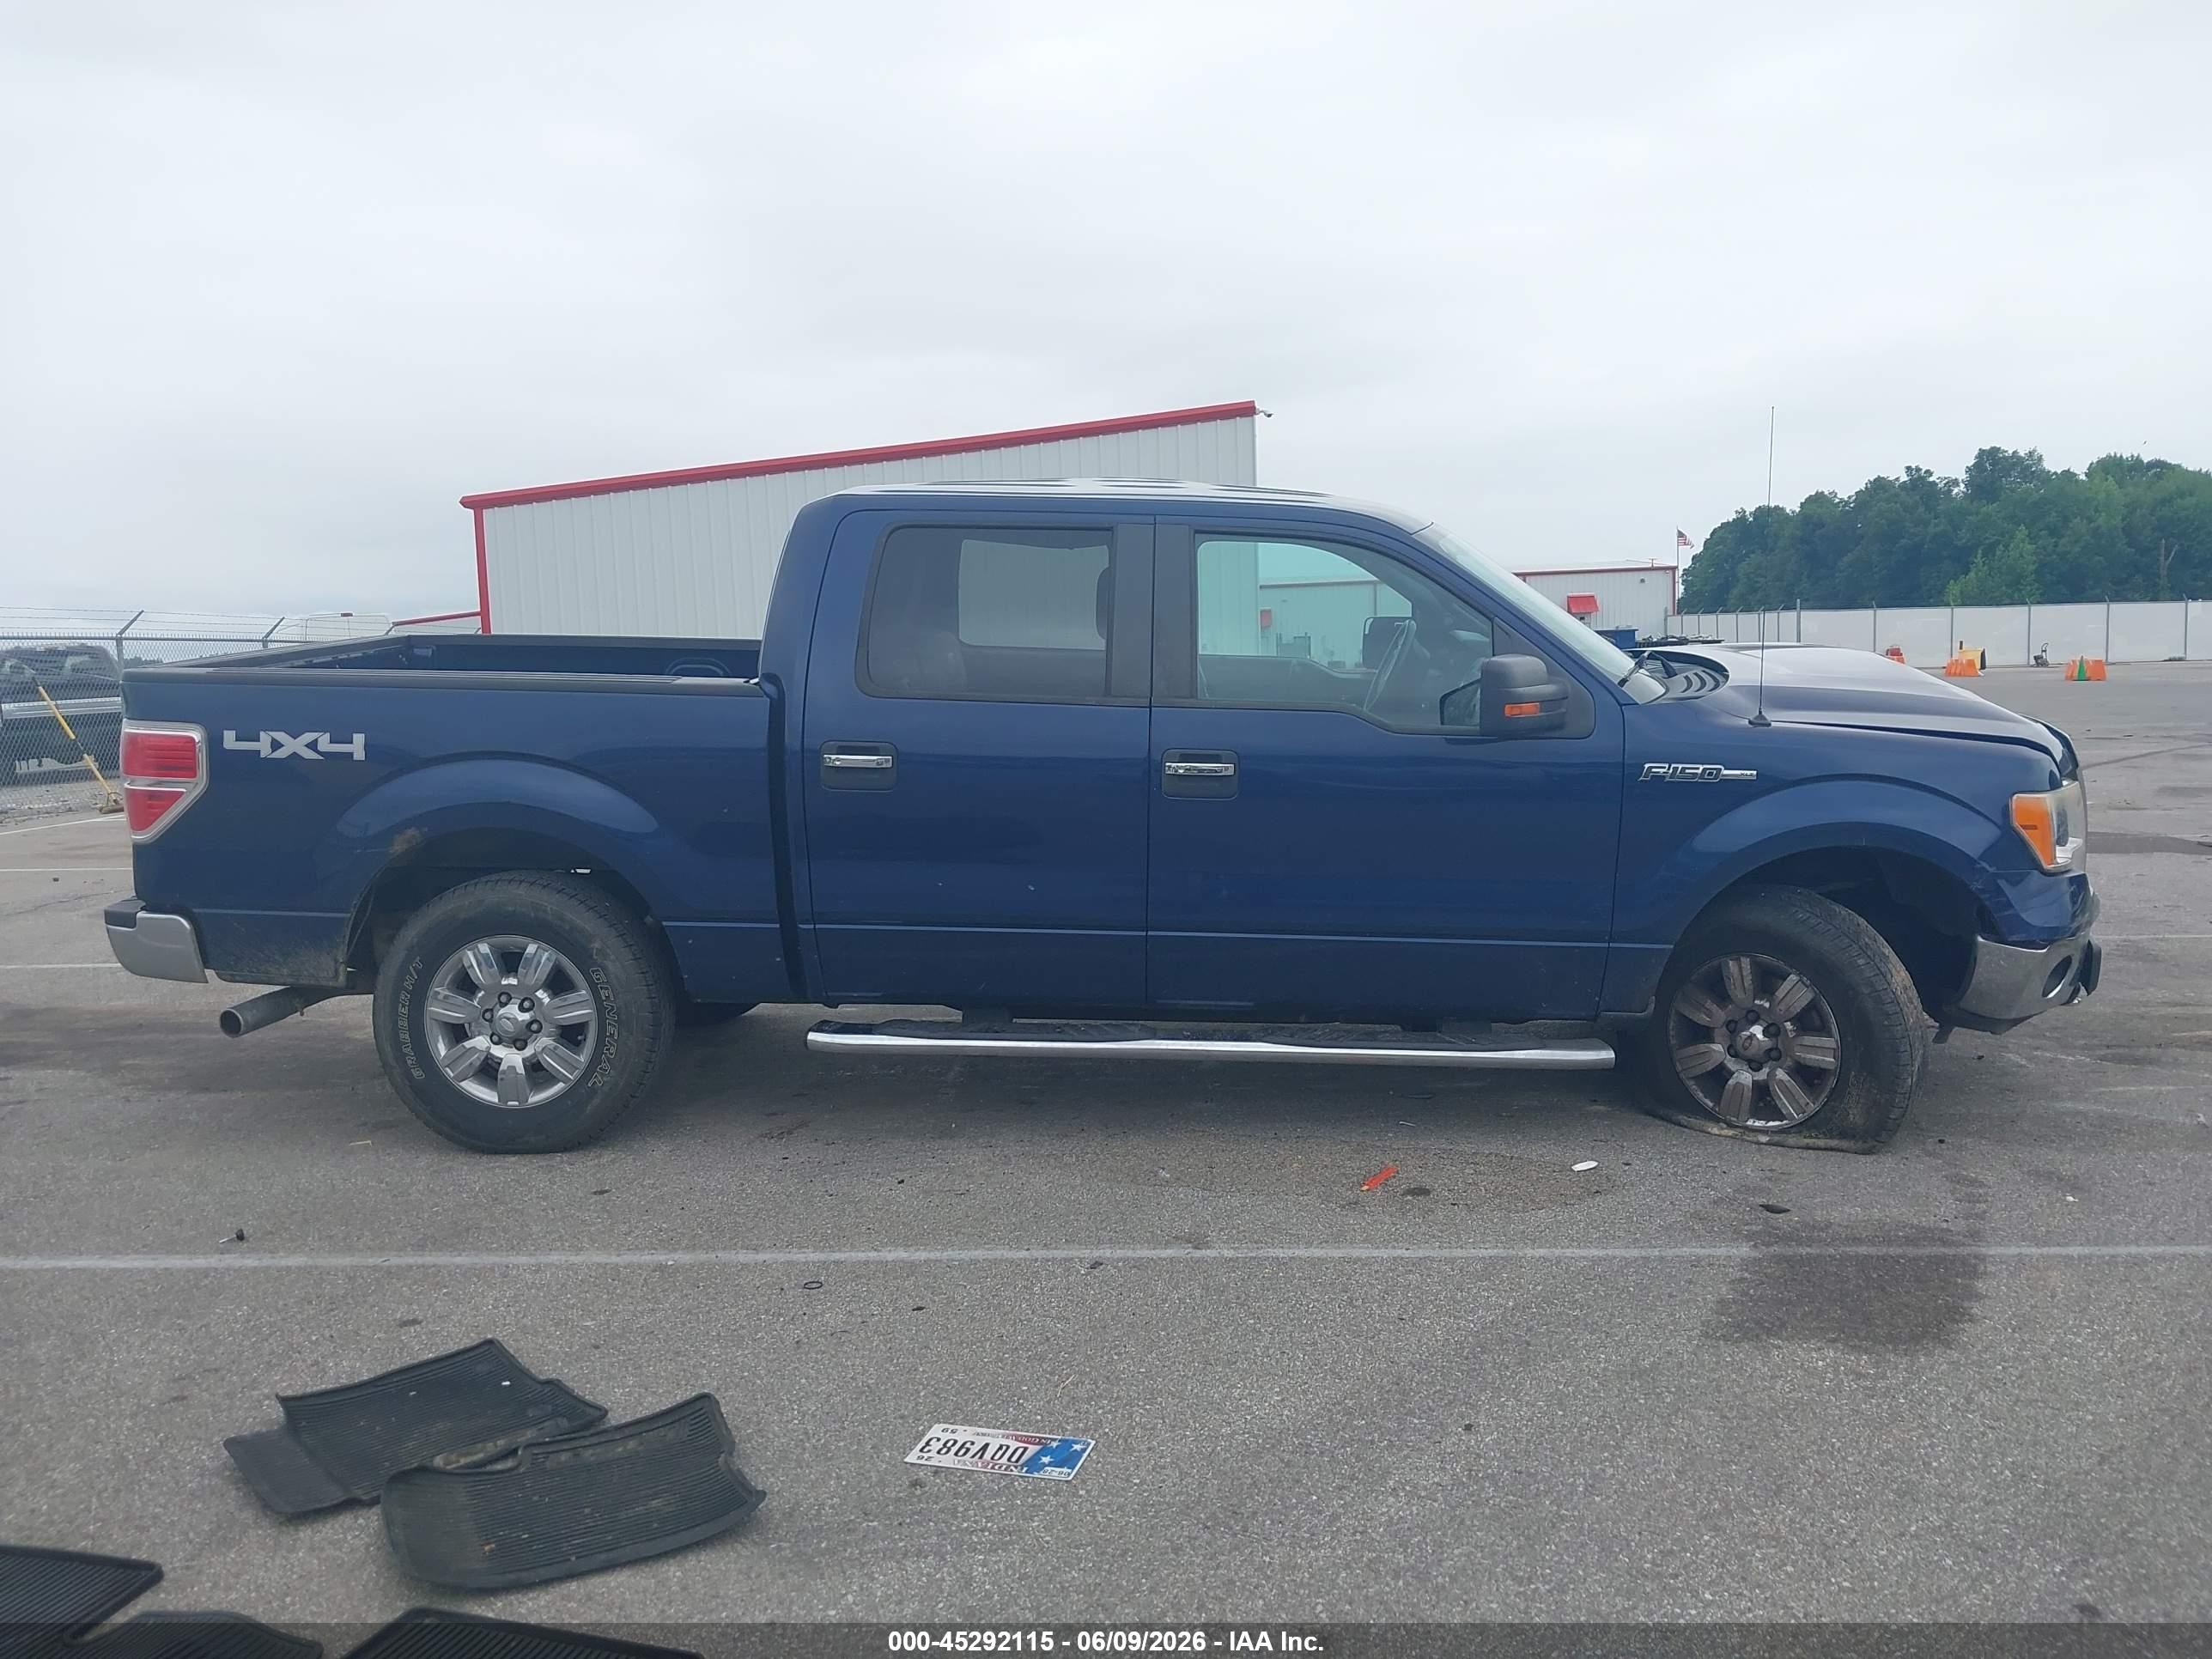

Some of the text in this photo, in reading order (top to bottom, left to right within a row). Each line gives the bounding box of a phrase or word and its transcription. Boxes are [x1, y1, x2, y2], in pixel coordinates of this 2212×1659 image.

[223, 730, 365, 761] 4X4
[1638, 763, 1725, 782] F-150
[398, 956, 425, 1079] GRABBER H/T
[588, 967, 618, 1087] GENERAL
[919, 1437, 1029, 1464] DQV983
[952, 1459, 1028, 1474] INDIANA
